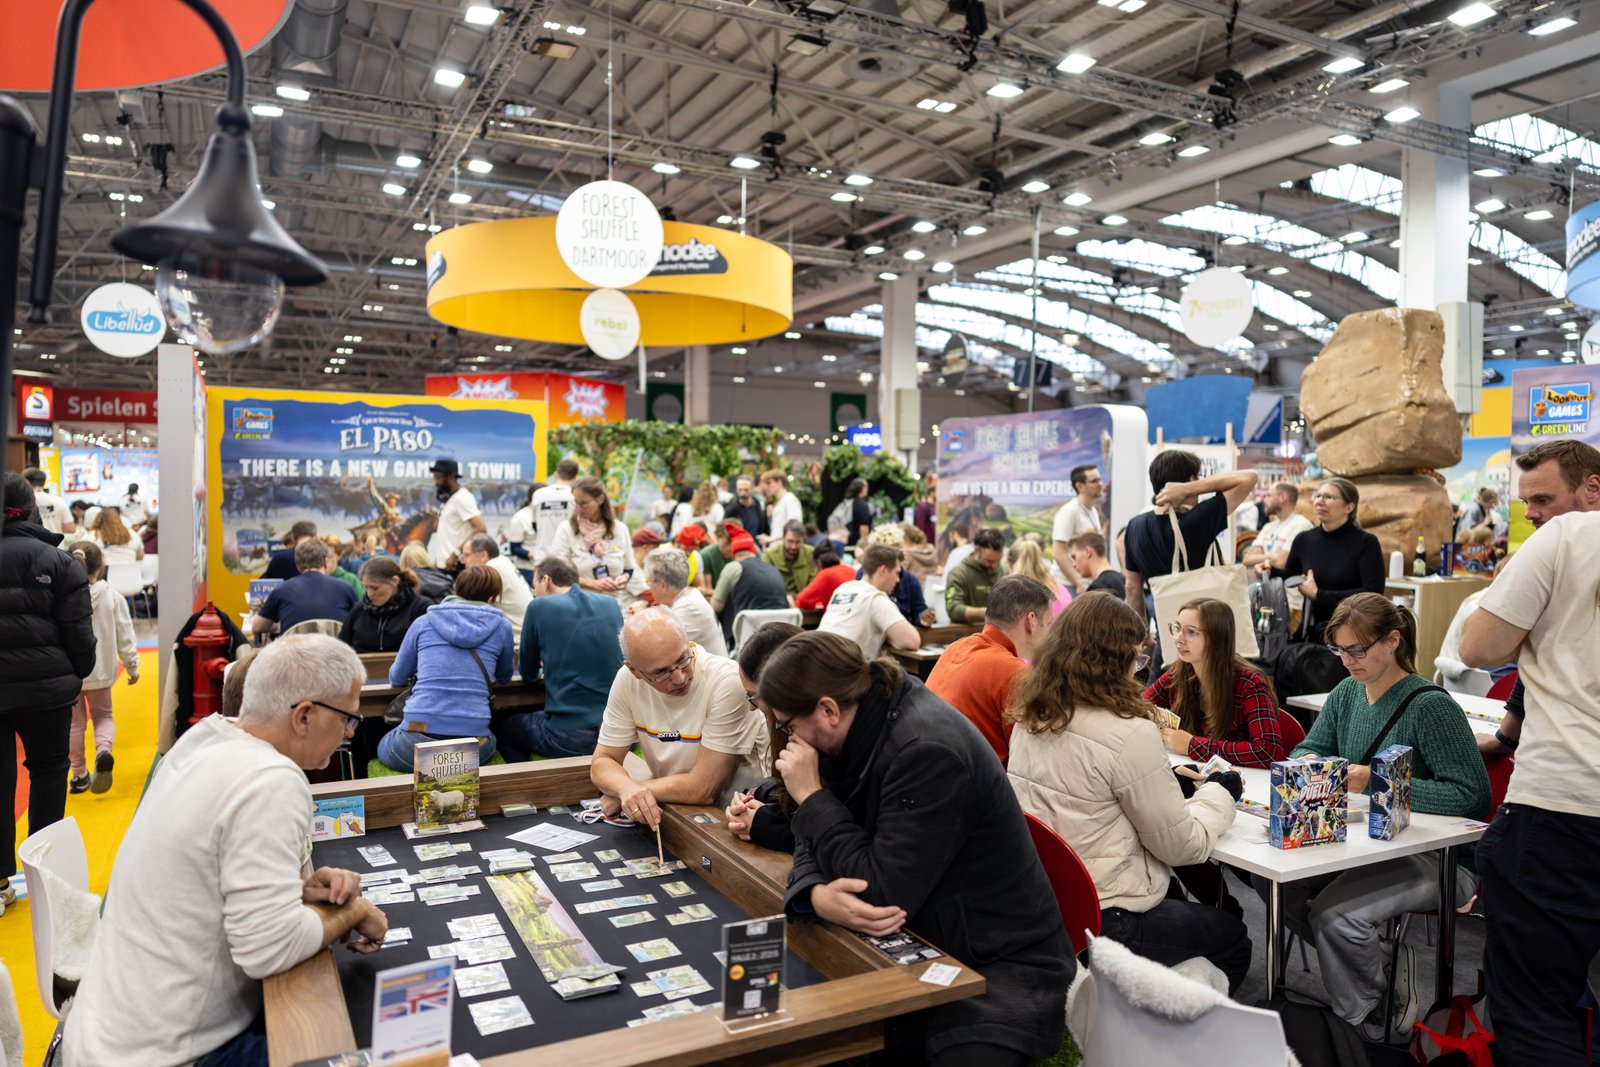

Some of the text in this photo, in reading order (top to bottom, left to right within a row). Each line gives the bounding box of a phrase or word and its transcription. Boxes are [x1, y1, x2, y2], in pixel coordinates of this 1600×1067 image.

[582, 192, 637, 219] FOREST
[581, 218, 639, 241] SHUFFLE
[572, 246, 647, 269] DARTMOOR
[662, 238, 717, 262] odee
[94, 309, 154, 332] Libellud
[594, 318, 628, 331] rebel
[68, 396, 147, 418] Spielen
[1548, 404, 1583, 418] GAMES
[340, 426, 433, 454] EL PASO
[1542, 423, 1588, 435] GREENLINE
[239, 458, 300, 477] THERE
[305, 459, 324, 477] IS
[329, 459, 342, 477] A
[347, 459, 389, 478] NEW
[468, 461, 522, 480] TOWN!
[1012, 480, 1030, 495] NEW
[1032, 480, 1076, 496] EXPERIE
[433, 751, 465, 765] FOREST
[431, 763, 468, 779] SHUFFLE
[1299, 782, 1332, 803] DUELL!
